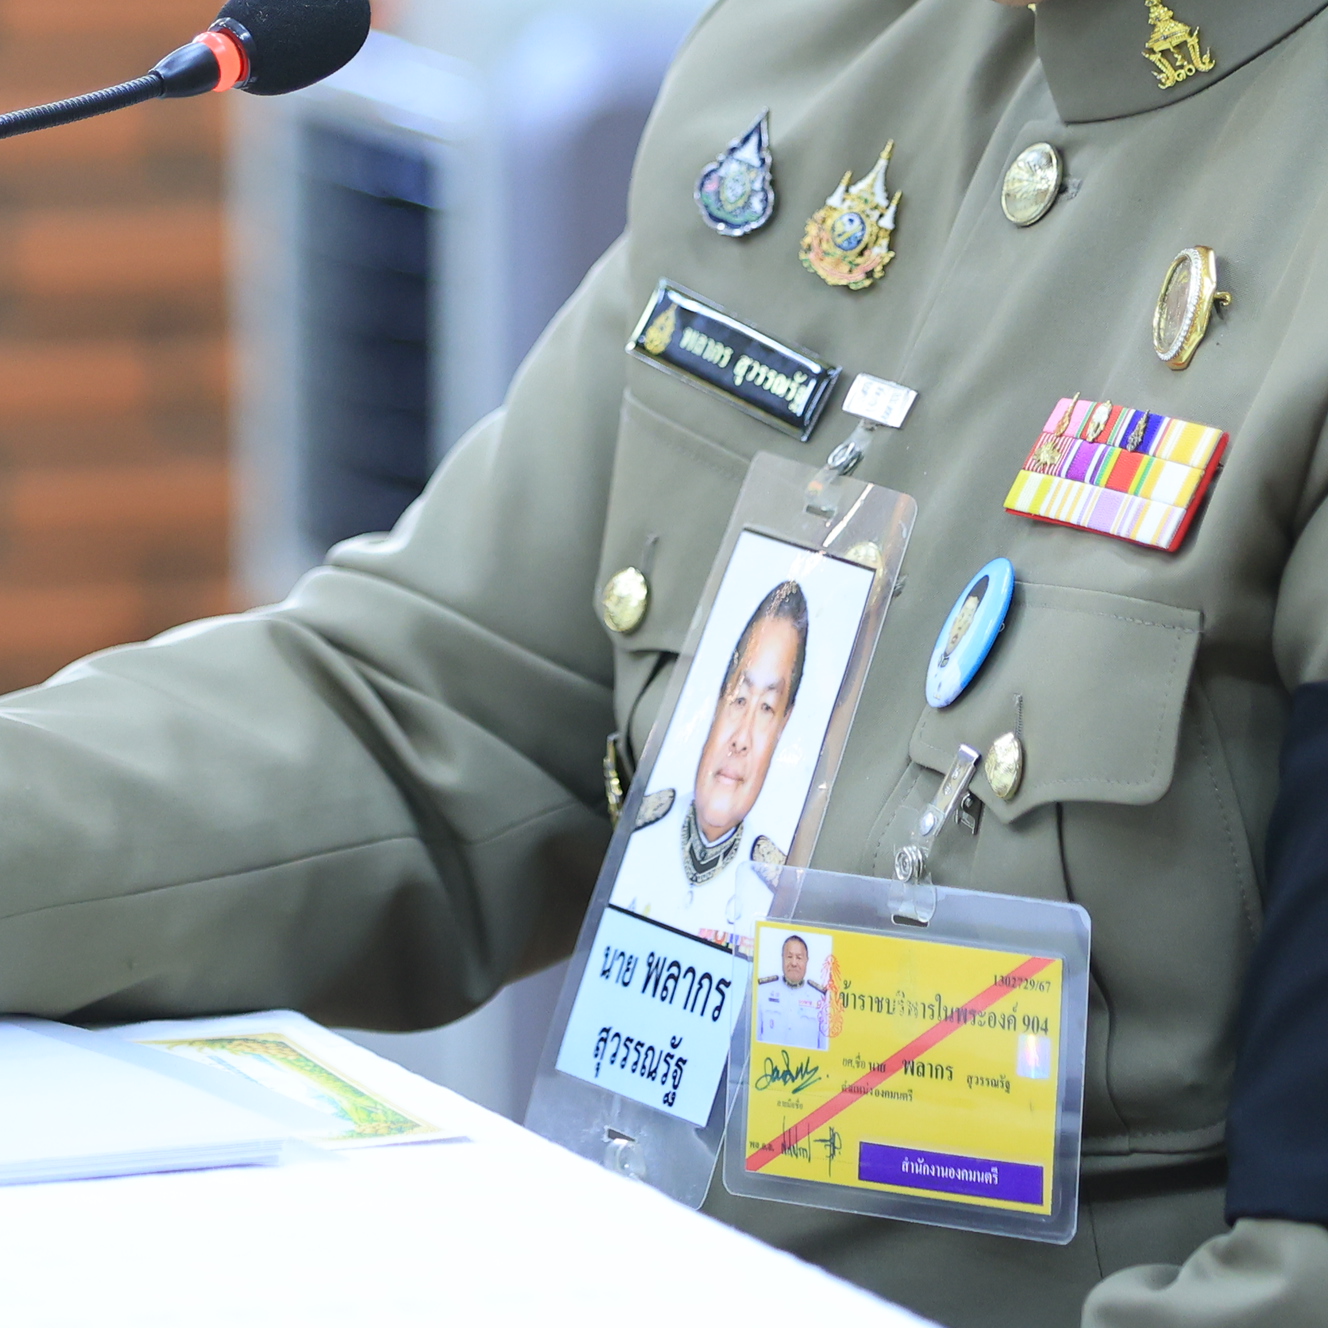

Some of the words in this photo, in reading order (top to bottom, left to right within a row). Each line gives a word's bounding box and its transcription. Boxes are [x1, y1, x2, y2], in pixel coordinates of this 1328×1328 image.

[598, 945, 638, 988] นาย
[642, 951, 732, 1023] พลากร
[1022, 1013, 1049, 1035] 904
[593, 1026, 689, 1108] สุวรรณรัฐ
[869, 1061, 886, 1073] นาย
[902, 1059, 954, 1082] พลากร
[966, 1074, 1011, 1095] สุวรรณรัฐ
[874, 1088, 914, 1102] องคมนตรี
[901, 1156, 999, 1186] สำนักงานองคมนตรี
